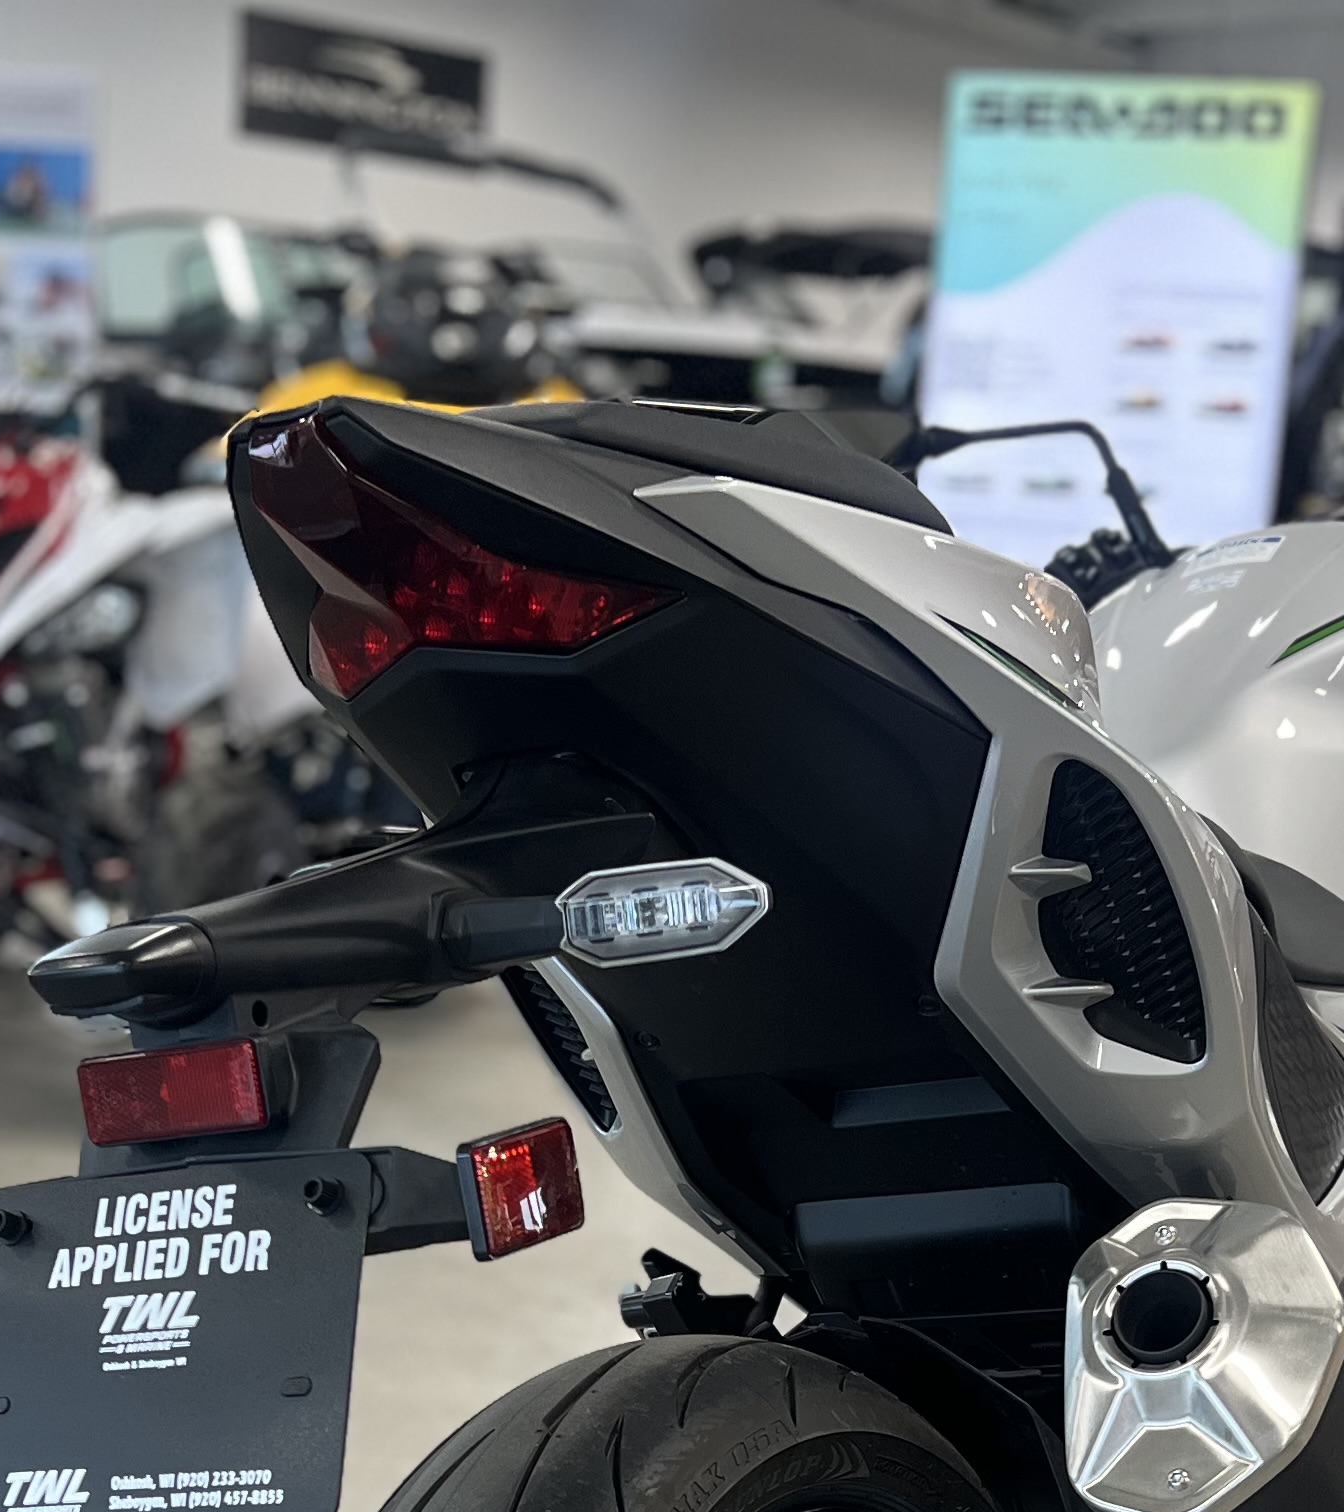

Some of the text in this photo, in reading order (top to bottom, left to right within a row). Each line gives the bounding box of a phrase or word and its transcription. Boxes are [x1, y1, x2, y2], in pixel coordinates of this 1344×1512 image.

[94, 1184, 237, 1238] LICENSE
[48, 1230, 272, 1289] APPLIED FOR
[99, 1291, 200, 1334] TWL
[3, 1468, 90, 1506] TWL
[176, 1471, 209, 1489] (920)
[211, 1469, 272, 1486] 233-3070
[188, 1490, 222, 1509] (920)
